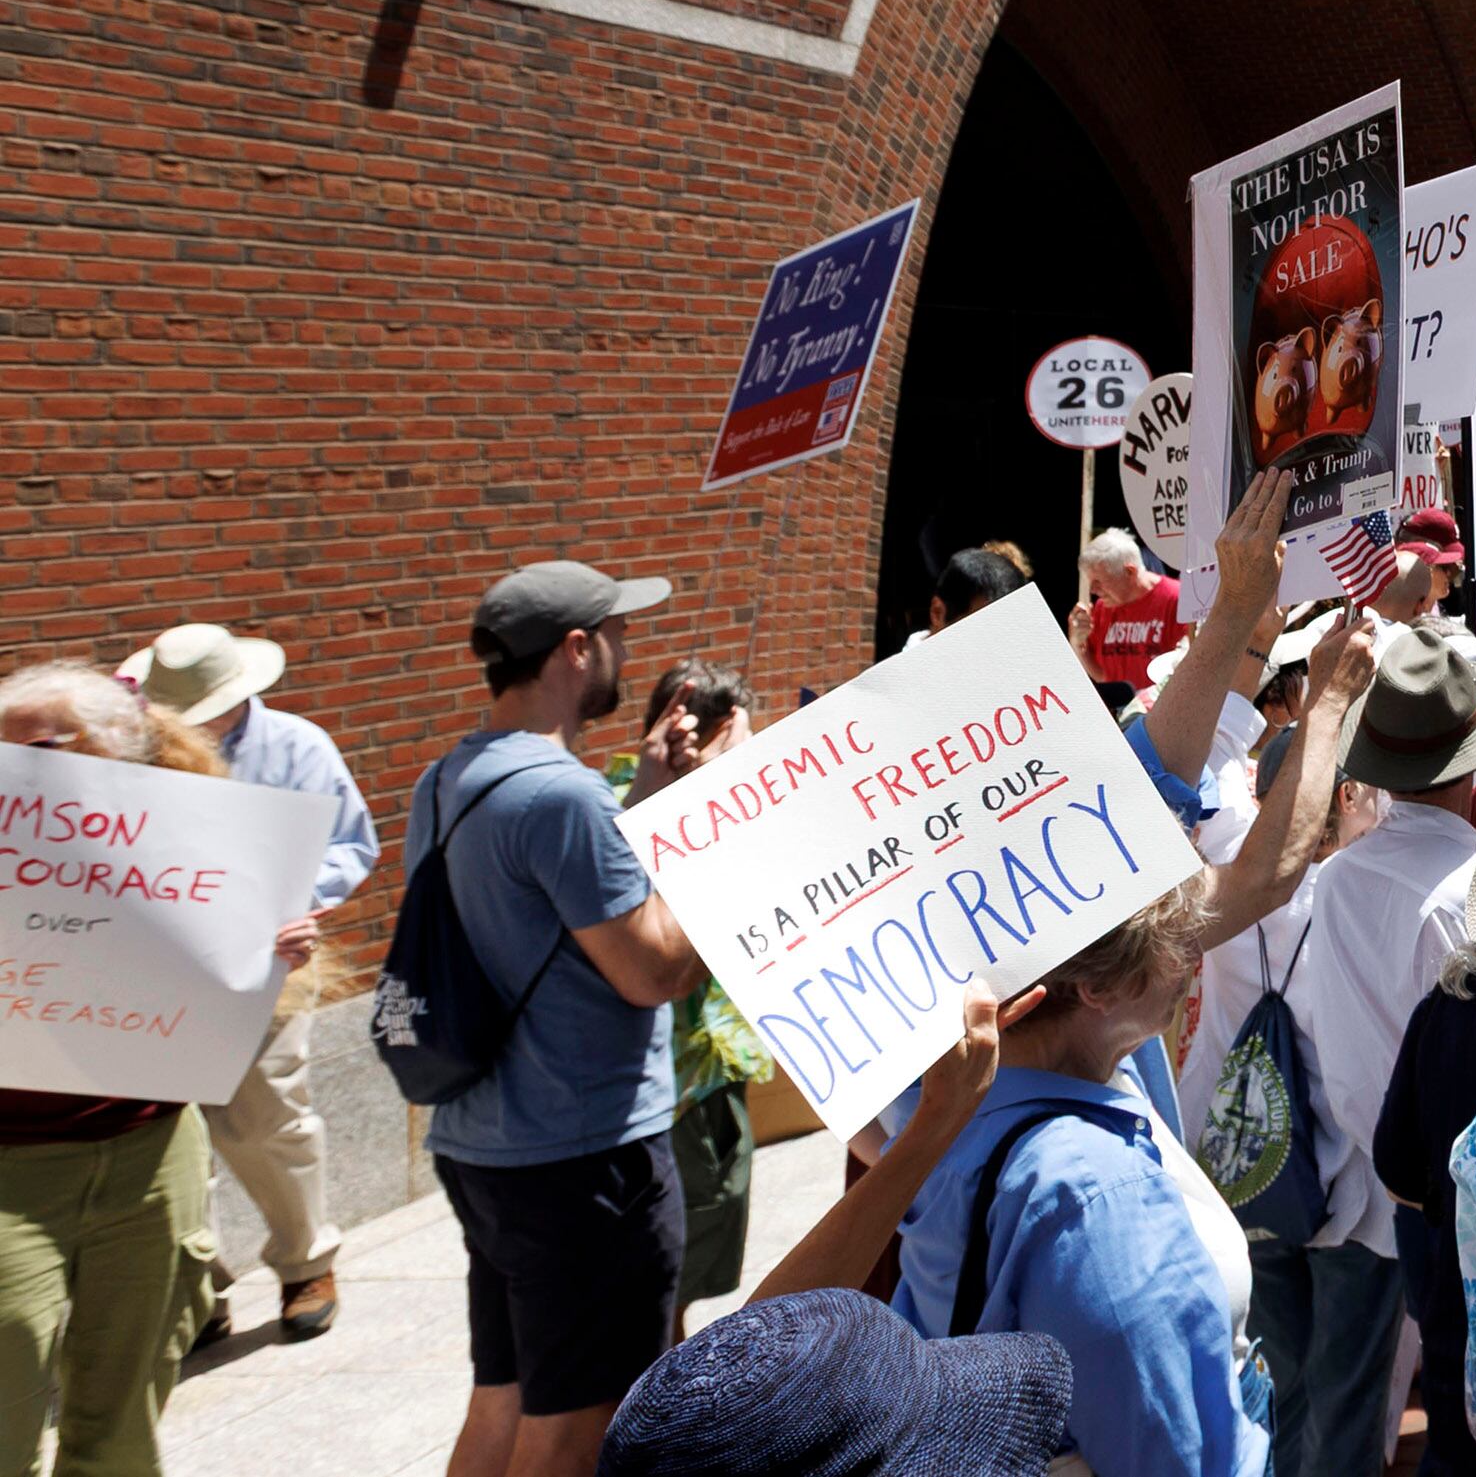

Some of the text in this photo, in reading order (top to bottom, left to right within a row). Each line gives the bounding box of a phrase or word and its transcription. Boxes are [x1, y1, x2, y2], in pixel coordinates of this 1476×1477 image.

[1236, 123, 1381, 212] THE USA IS
[1251, 180, 1367, 256] NOT FOR
[1406, 213, 1469, 271] HO'S
[765, 238, 876, 321] No King!
[1276, 240, 1343, 293] SALE
[743, 338, 778, 390] No
[776, 298, 879, 393] Tyranny!
[1406, 310, 1443, 362] T?
[1050, 358, 1133, 373] LOCAL
[1056, 376, 1125, 410] 26
[1048, 415, 1127, 428] UNITEHERE
[1123, 386, 1192, 476] HARV
[1403, 431, 1433, 455] VER
[1153, 476, 1188, 501] ACAD
[1304, 461, 1318, 483] &
[1322, 447, 1373, 474] Trump
[1294, 492, 1333, 518] Go to
[1401, 475, 1438, 509] ARD
[1152, 503, 1188, 535] FRE
[850, 684, 1071, 822] FREEDOM
[0, 794, 148, 847] IMSON
[650, 719, 876, 873] ACADEMIC
[0, 847, 228, 903] COURAGE
[735, 756, 1061, 961] IS A PILLAR OF OUR
[25, 913, 112, 934] over
[756, 782, 1140, 1106] DEMOCRACY
[0, 957, 62, 987] GE
